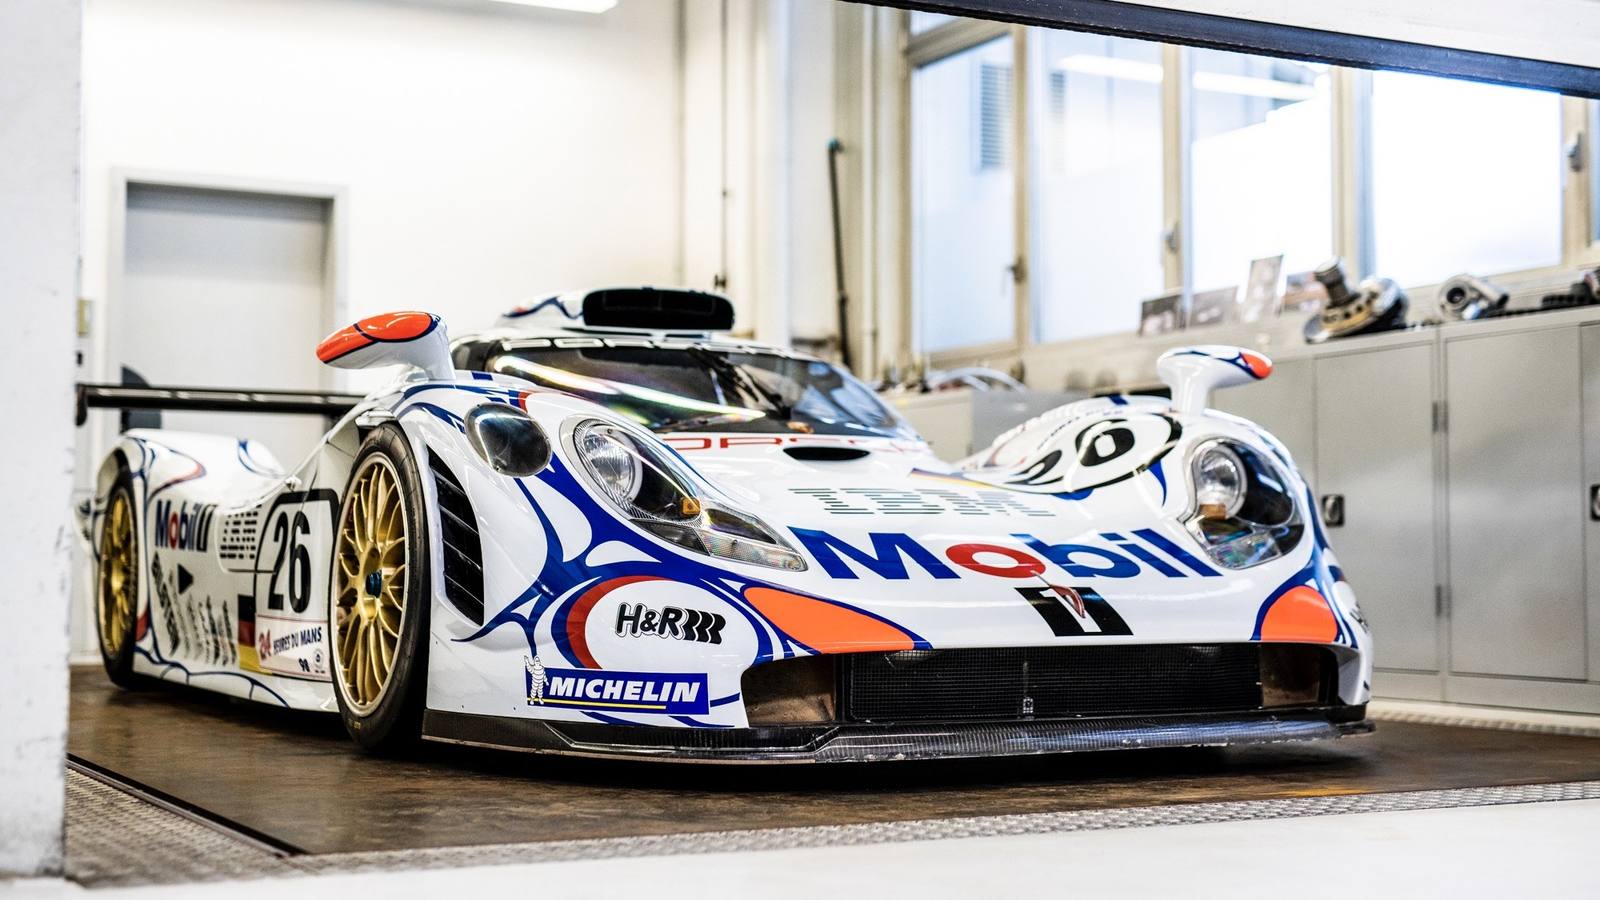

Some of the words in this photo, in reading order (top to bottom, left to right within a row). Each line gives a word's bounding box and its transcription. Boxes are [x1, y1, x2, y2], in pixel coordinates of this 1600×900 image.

[787, 487, 1056, 517] IBM
[155, 499, 203, 551] Mobil
[267, 510, 312, 614] 26
[787, 526, 1223, 580] Mobil
[300, 626, 322, 646] MANS
[549, 676, 701, 703] MICHELIN
